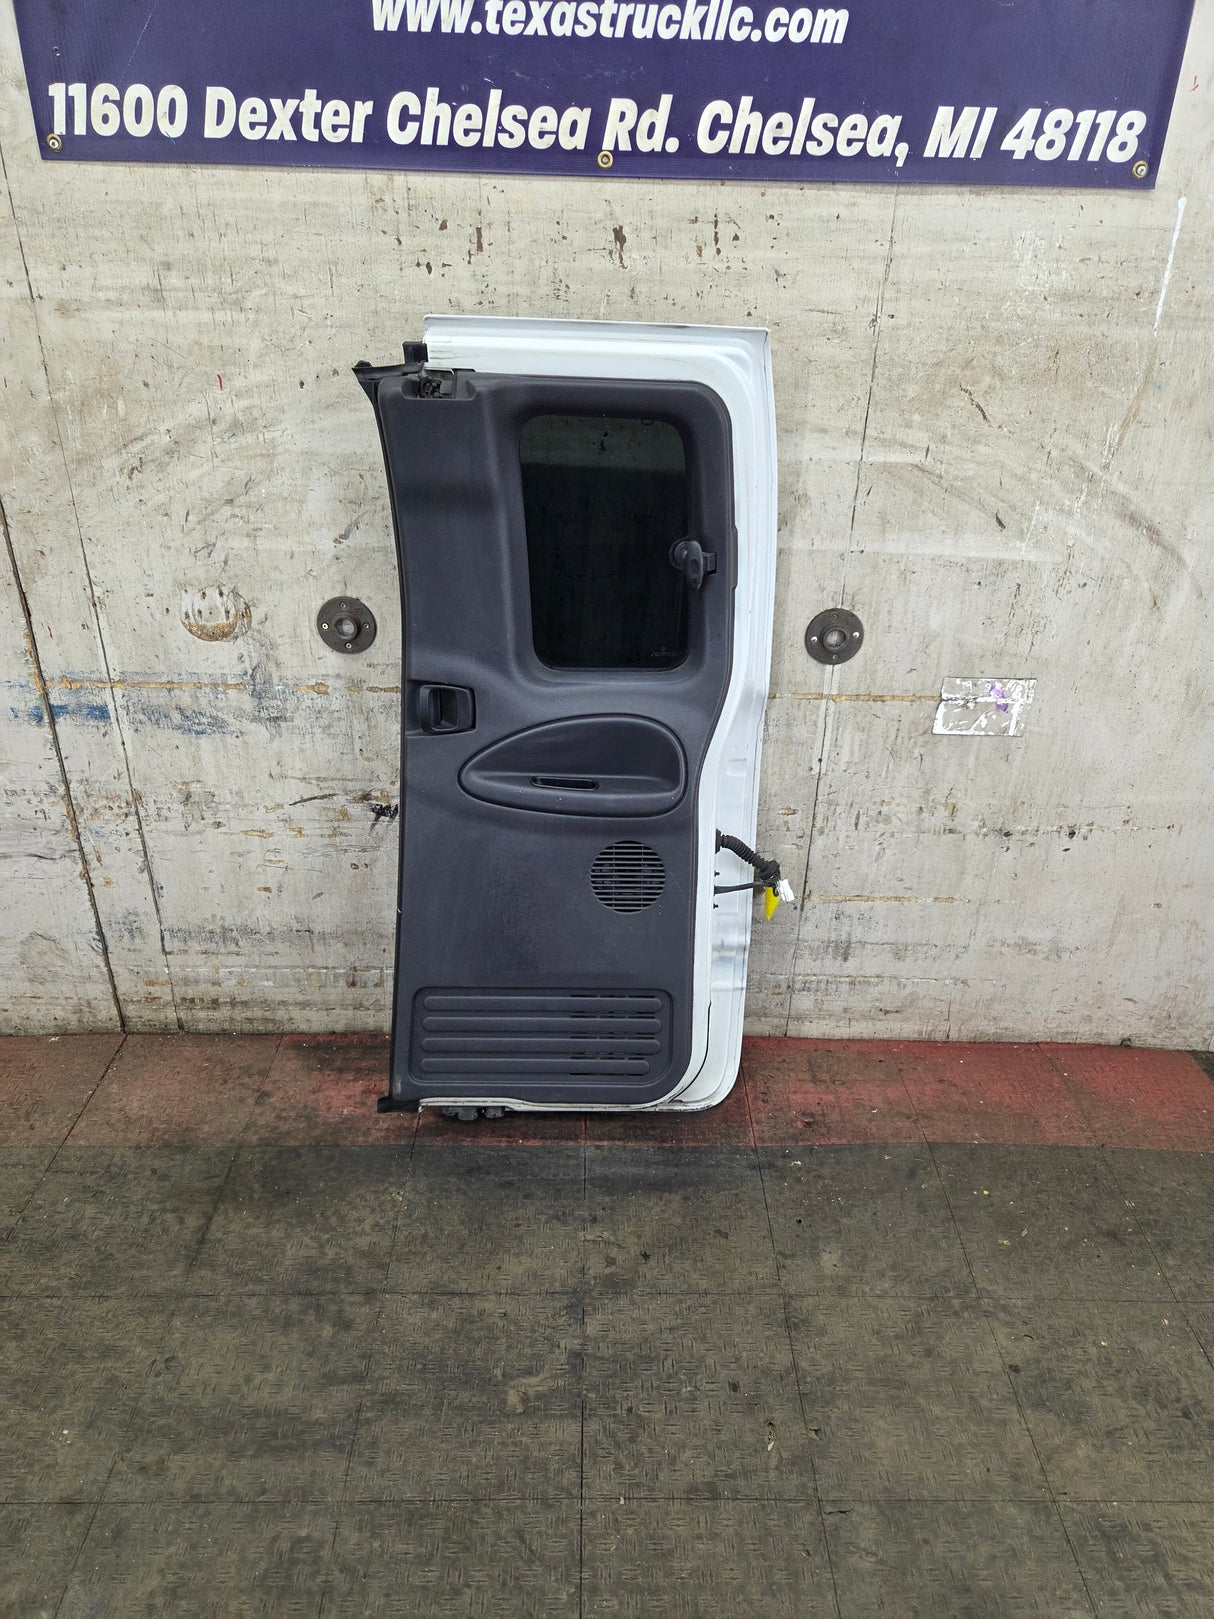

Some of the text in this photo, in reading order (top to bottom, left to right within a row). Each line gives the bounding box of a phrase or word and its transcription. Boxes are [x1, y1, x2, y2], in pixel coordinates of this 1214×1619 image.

[371, 0, 849, 44] www.texastruckllc.com
[47, 82, 1147, 168] 11600 Dexter Chelsea Rd. Chelsea, MI 48118
